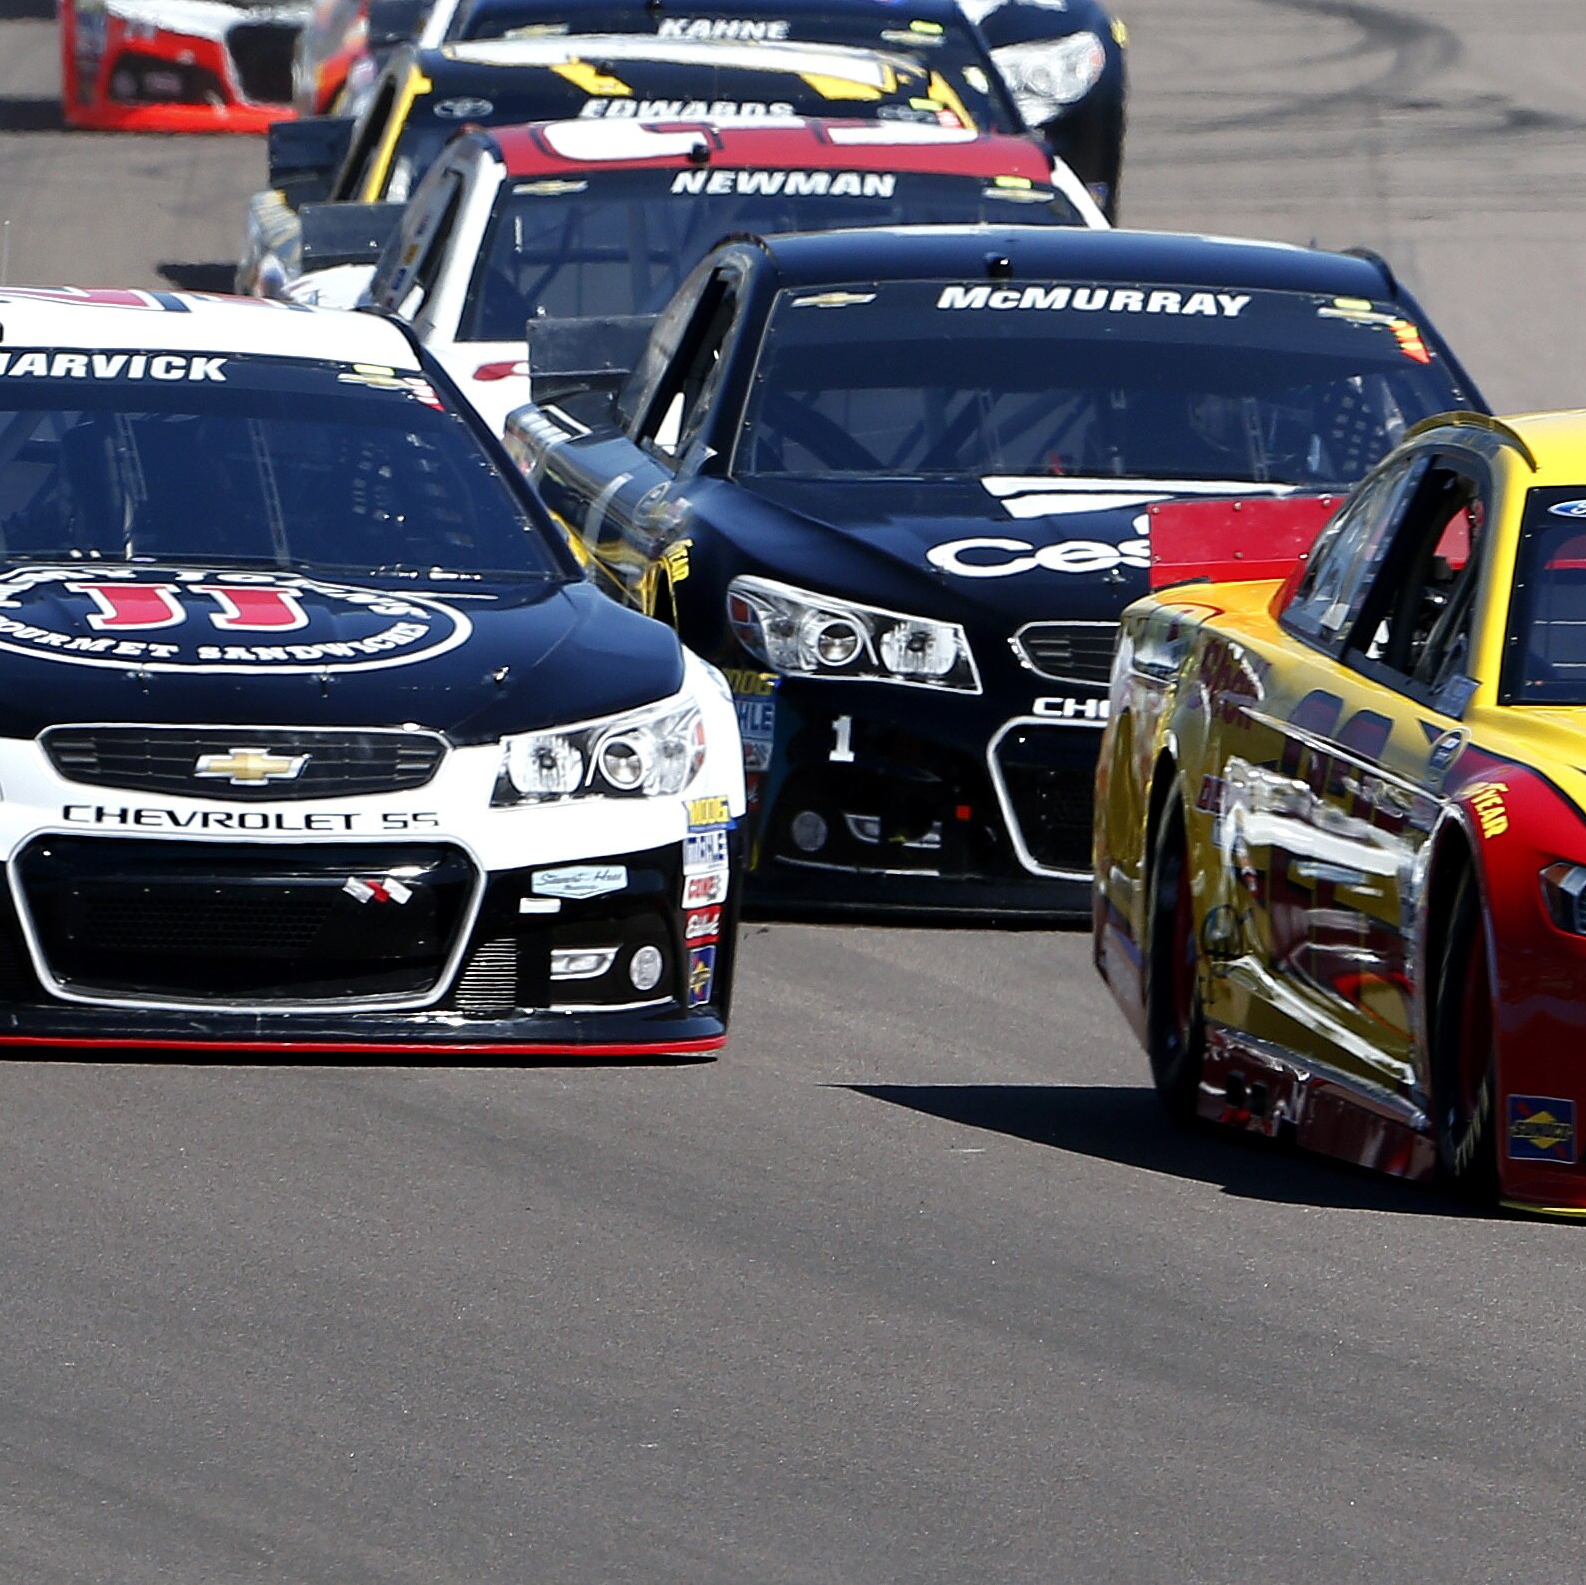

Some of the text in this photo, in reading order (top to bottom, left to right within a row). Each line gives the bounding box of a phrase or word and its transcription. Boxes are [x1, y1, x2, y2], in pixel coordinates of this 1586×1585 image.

[657, 17, 792, 41] KAHNE
[578, 97, 797, 118] EDWARDS
[670, 169, 897, 199] NEWMAN
[935, 283, 1253, 318] McMURRAY
[722, 668, 777, 697] OOG
[828, 714, 856, 763] 1
[61, 803, 441, 832] CHEVROLET SS
